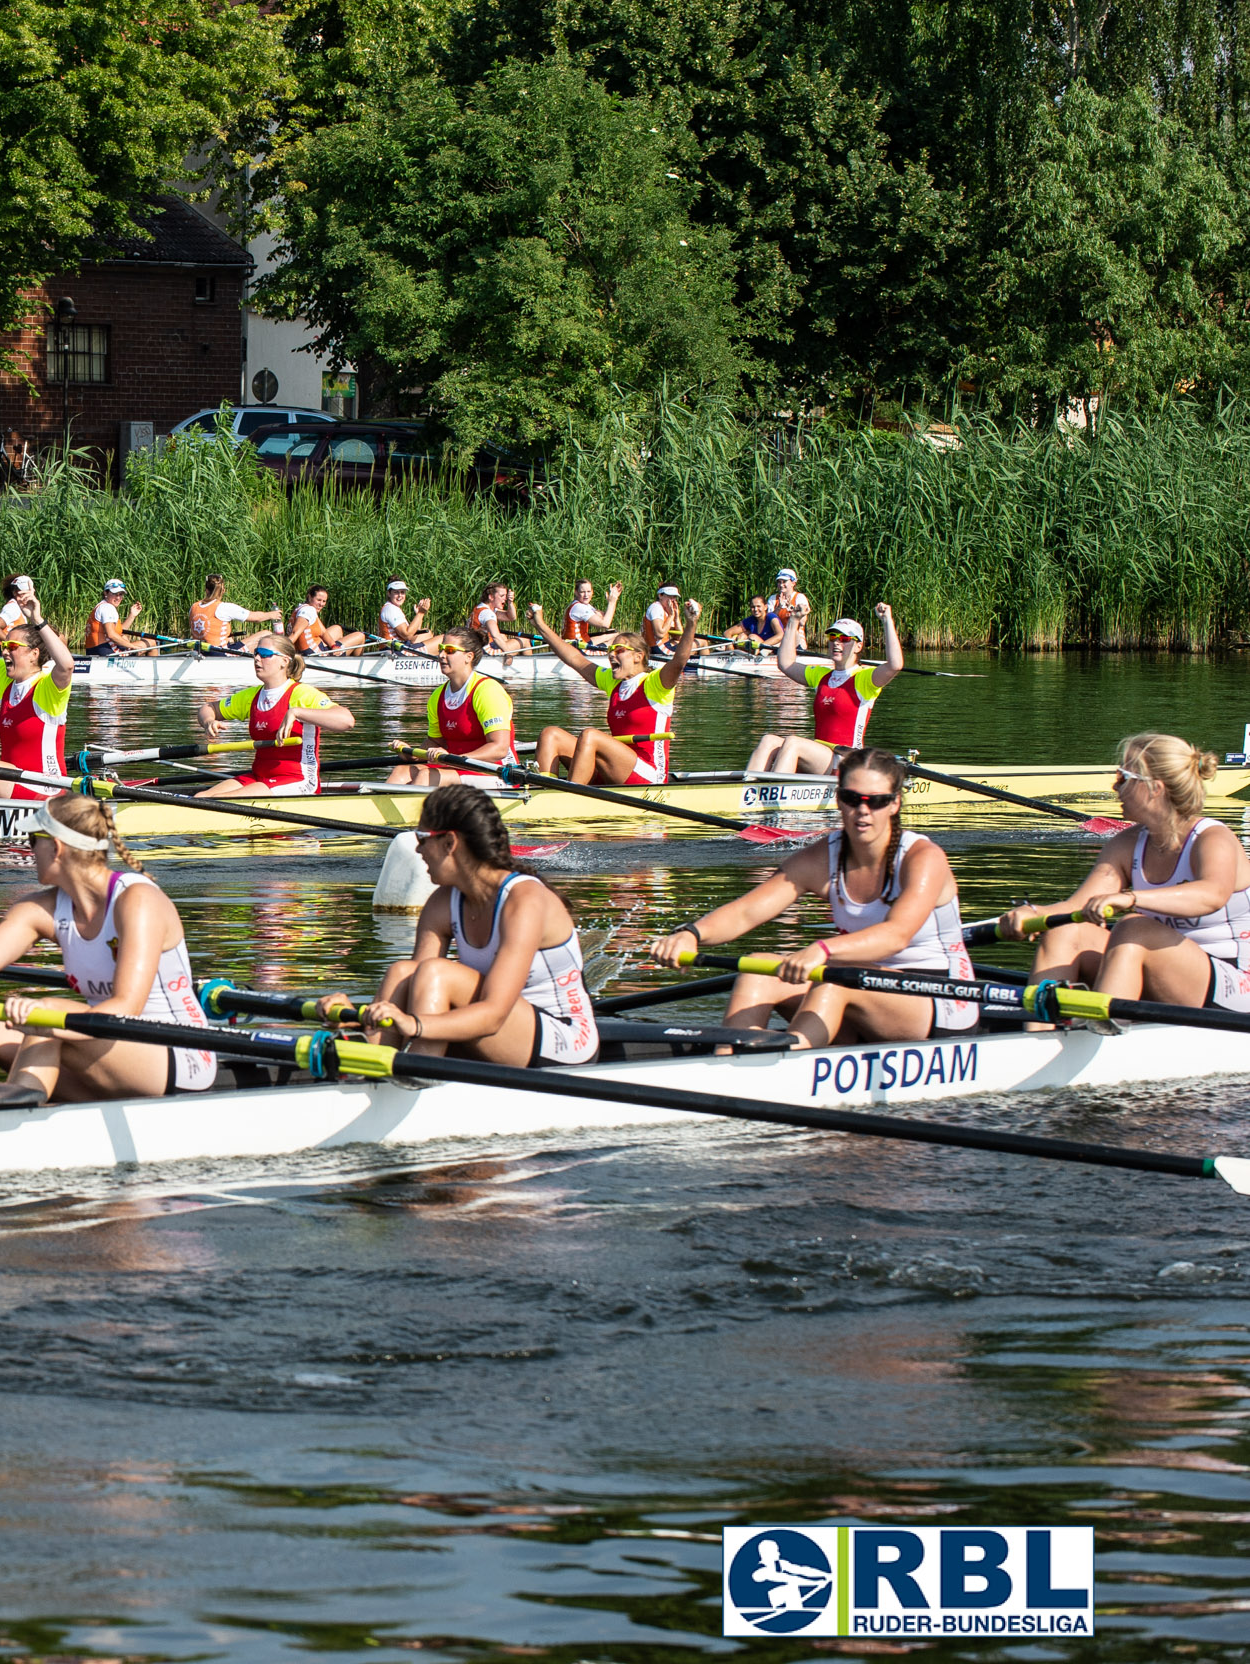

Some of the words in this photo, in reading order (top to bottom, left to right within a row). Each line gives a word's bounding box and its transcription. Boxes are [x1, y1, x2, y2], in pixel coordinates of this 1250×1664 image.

[395, 660, 440, 671] ESSEN-KETT
[759, 786, 788, 801] RBL
[791, 784, 837, 800] RUDER-BU
[167, 975, 189, 993] 8
[862, 976, 901, 990] STARK.
[954, 985, 981, 998] GUT.
[988, 986, 1019, 1001] RBL
[811, 1042, 978, 1096] POTSDAM
